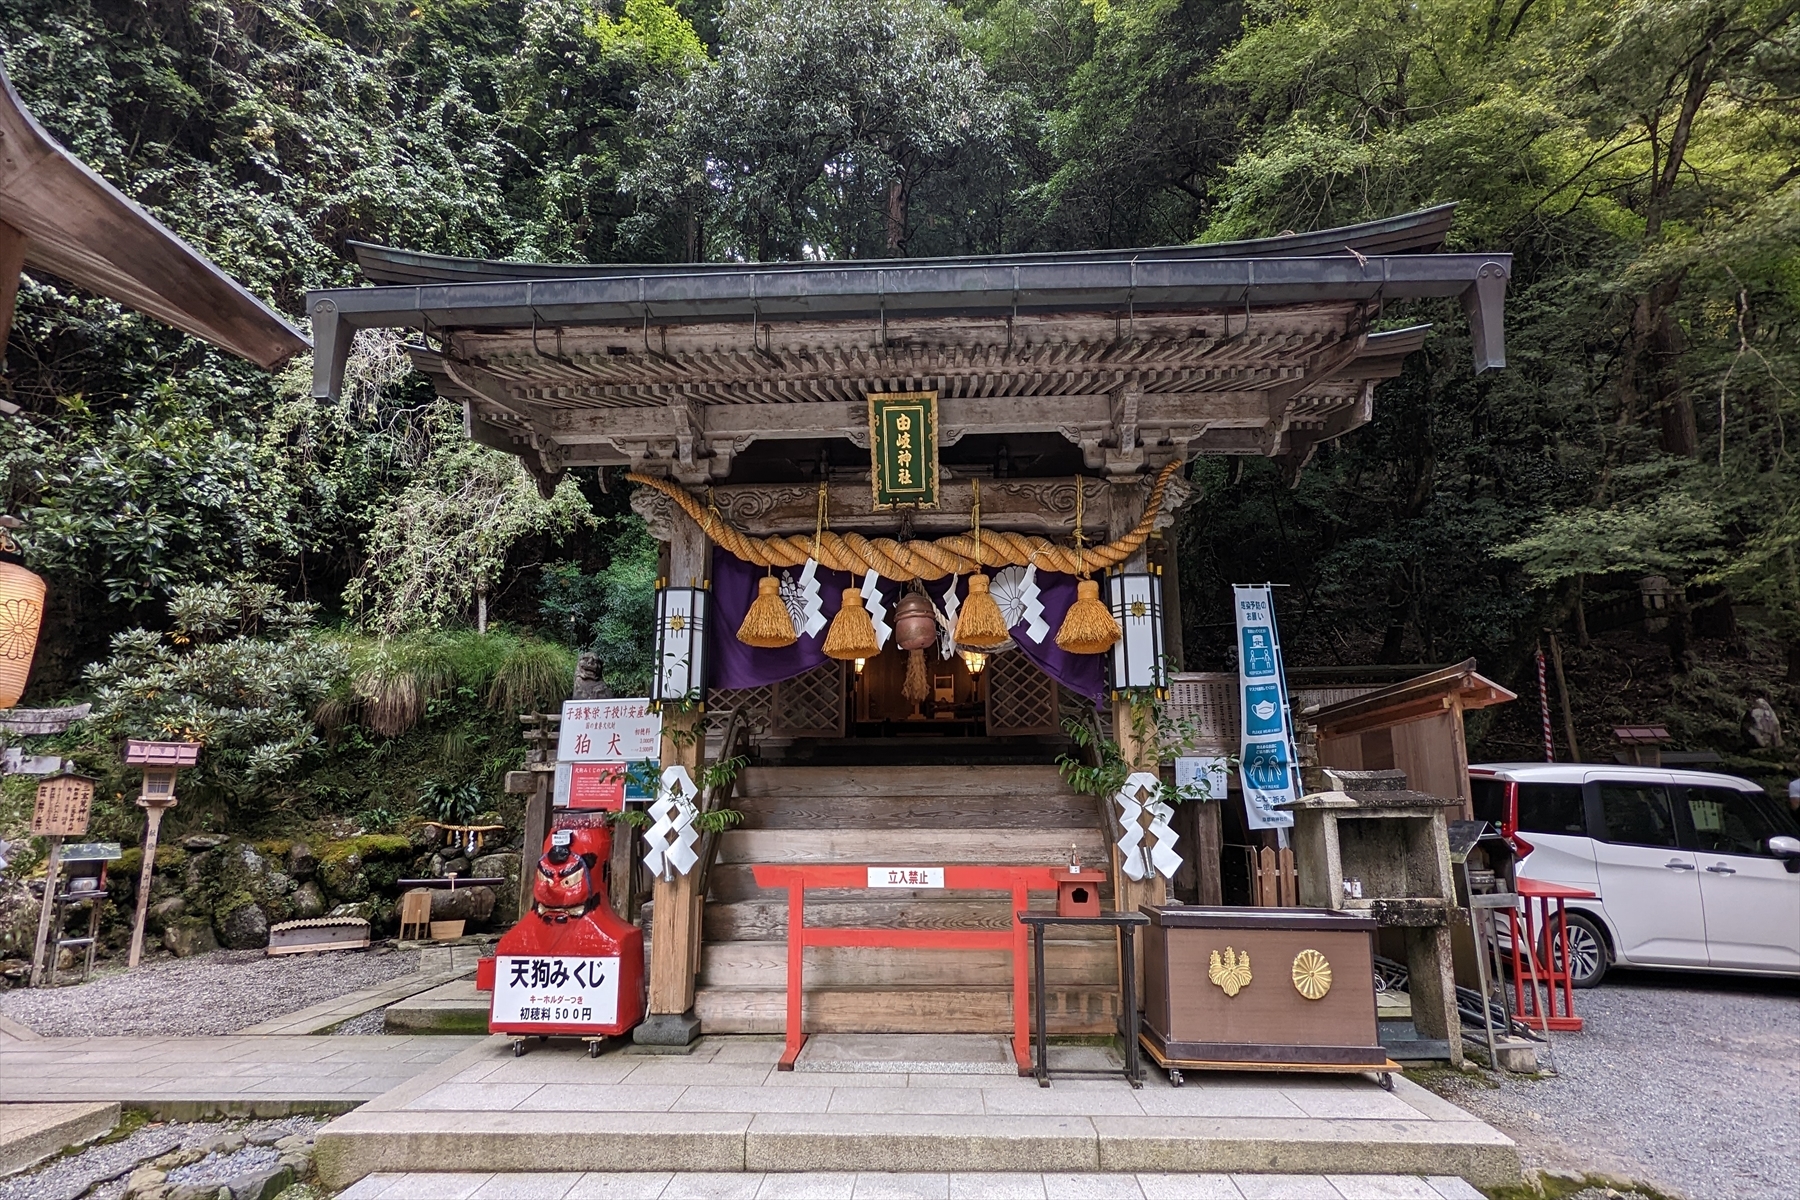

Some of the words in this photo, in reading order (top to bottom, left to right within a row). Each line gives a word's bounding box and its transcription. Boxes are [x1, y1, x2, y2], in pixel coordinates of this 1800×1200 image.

[896, 413, 913, 485] 由岐神社
[1241, 601, 1266, 610] 感染予防の
[1246, 612, 1264, 621] お願い
[585, 722, 616, 730] 国の重要文化財
[888, 870, 929, 884] 立入禁止
[509, 959, 605, 989] 天狗みくじ
[530, 995, 583, 1004] キーホルダーつき
[520, 1007, 551, 1021] 初穂料
[555, 1007, 592, 1021] 500円
